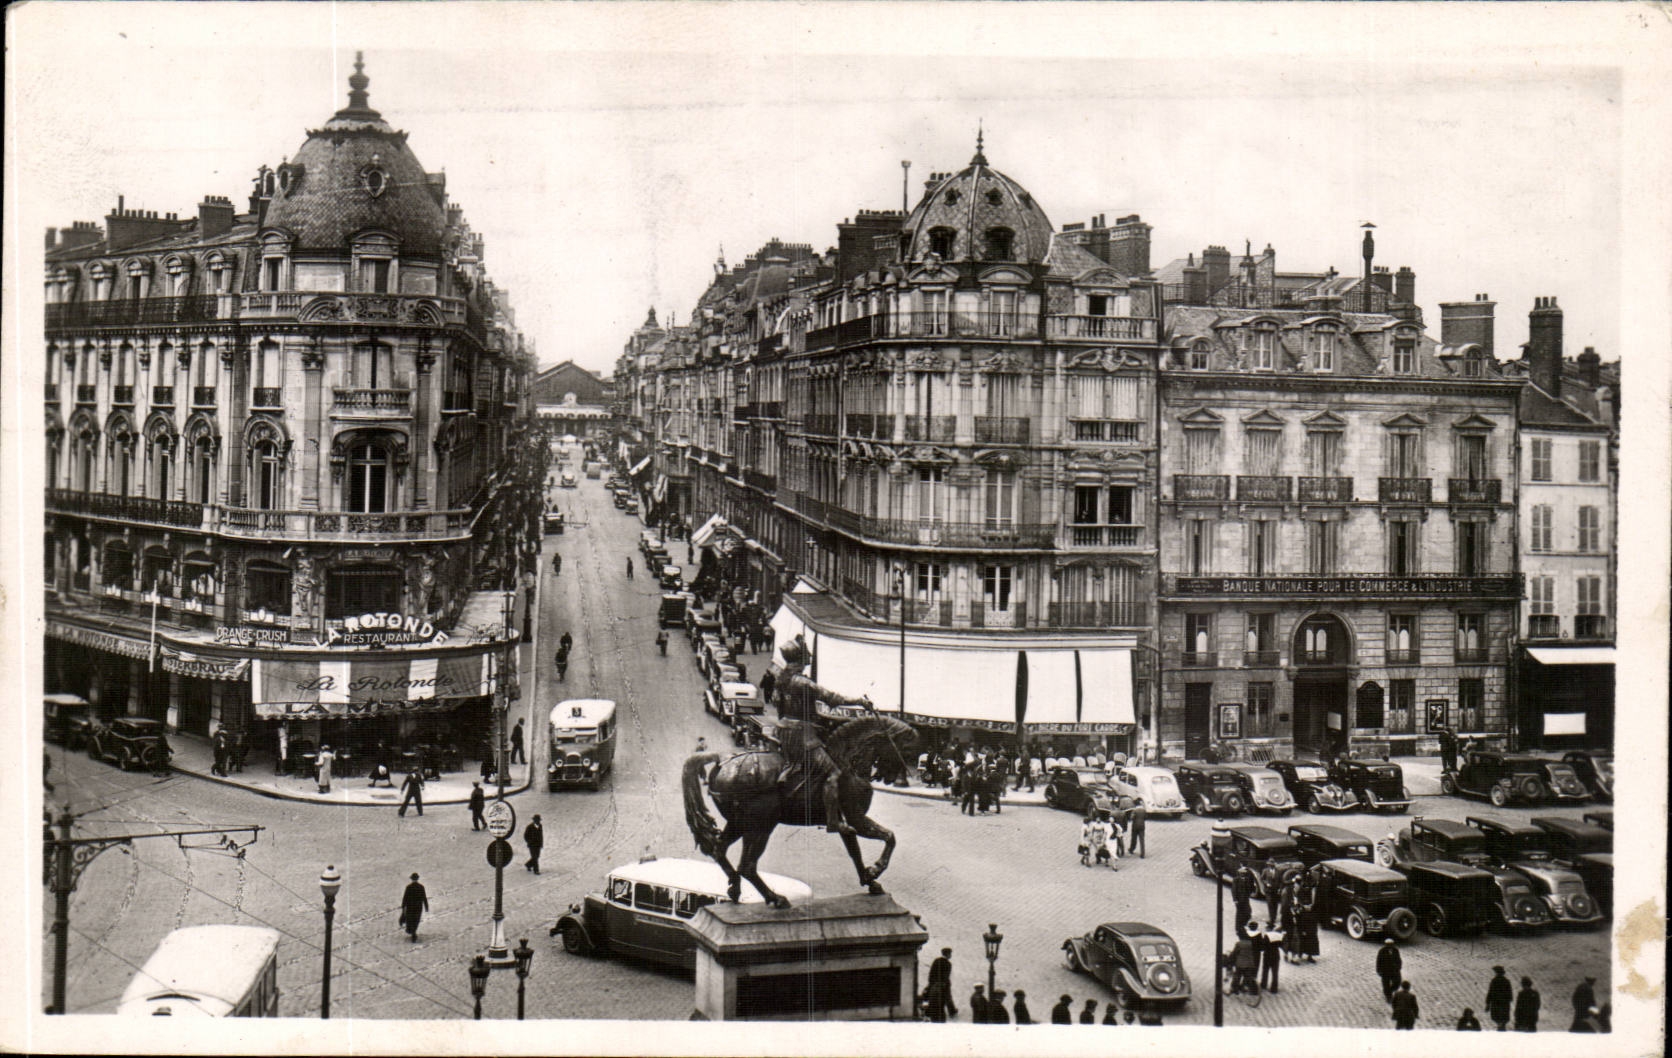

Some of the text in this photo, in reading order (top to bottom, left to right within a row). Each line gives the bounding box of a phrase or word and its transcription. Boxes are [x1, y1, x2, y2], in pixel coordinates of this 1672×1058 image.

[1223, 579, 1260, 593] BANQUE
[1265, 579, 1313, 593] NATIONALE
[1317, 580, 1341, 593] POUR
[1344, 580, 1355, 592] LE
[1359, 580, 1408, 592] COMMERCE
[1411, 582, 1417, 592] &
[312, 612, 449, 649] LA ROTONDE
[343, 633, 416, 643] RESTAURANT
[296, 674, 454, 691] La Rotonde
[285, 700, 329, 714] LA
